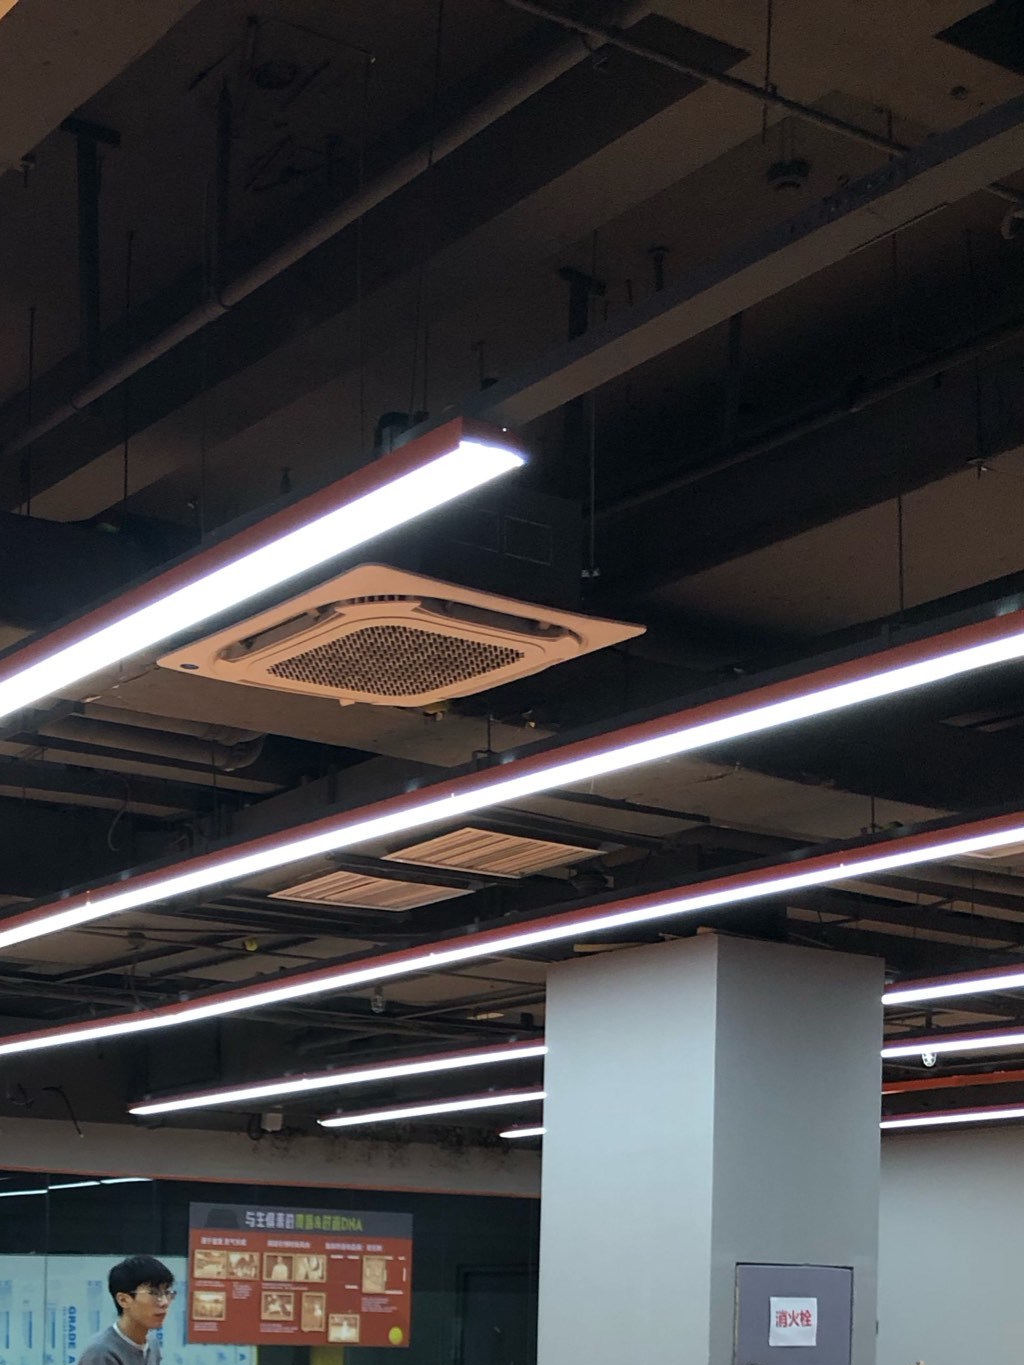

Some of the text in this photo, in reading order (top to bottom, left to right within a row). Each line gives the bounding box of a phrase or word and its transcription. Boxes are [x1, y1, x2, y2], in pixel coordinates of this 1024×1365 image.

[68, 1306, 77, 1349] GRADE
[775, 1310, 812, 1328] 消火栓
